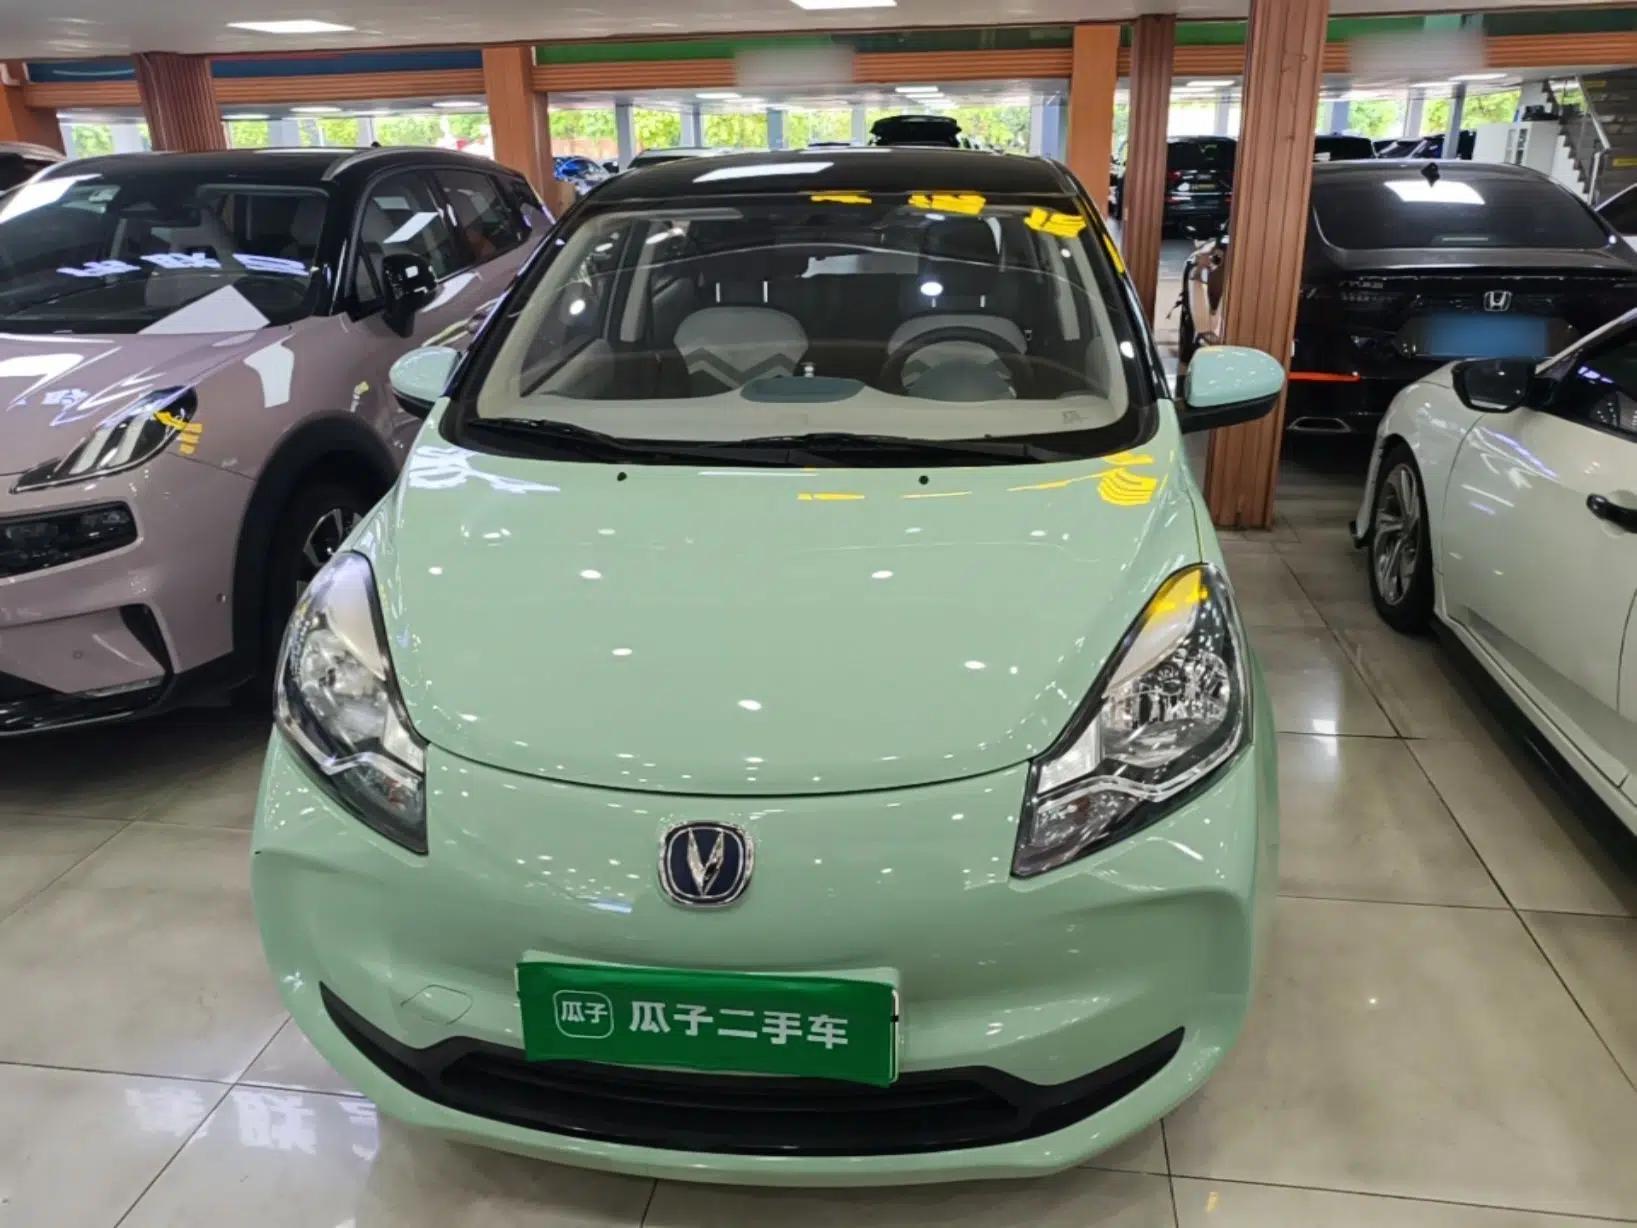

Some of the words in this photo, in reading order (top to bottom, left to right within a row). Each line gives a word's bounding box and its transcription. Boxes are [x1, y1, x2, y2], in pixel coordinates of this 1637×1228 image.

[560, 1000, 608, 1024] 瓜子
[629, 1000, 848, 1050] 瓜子二手车
